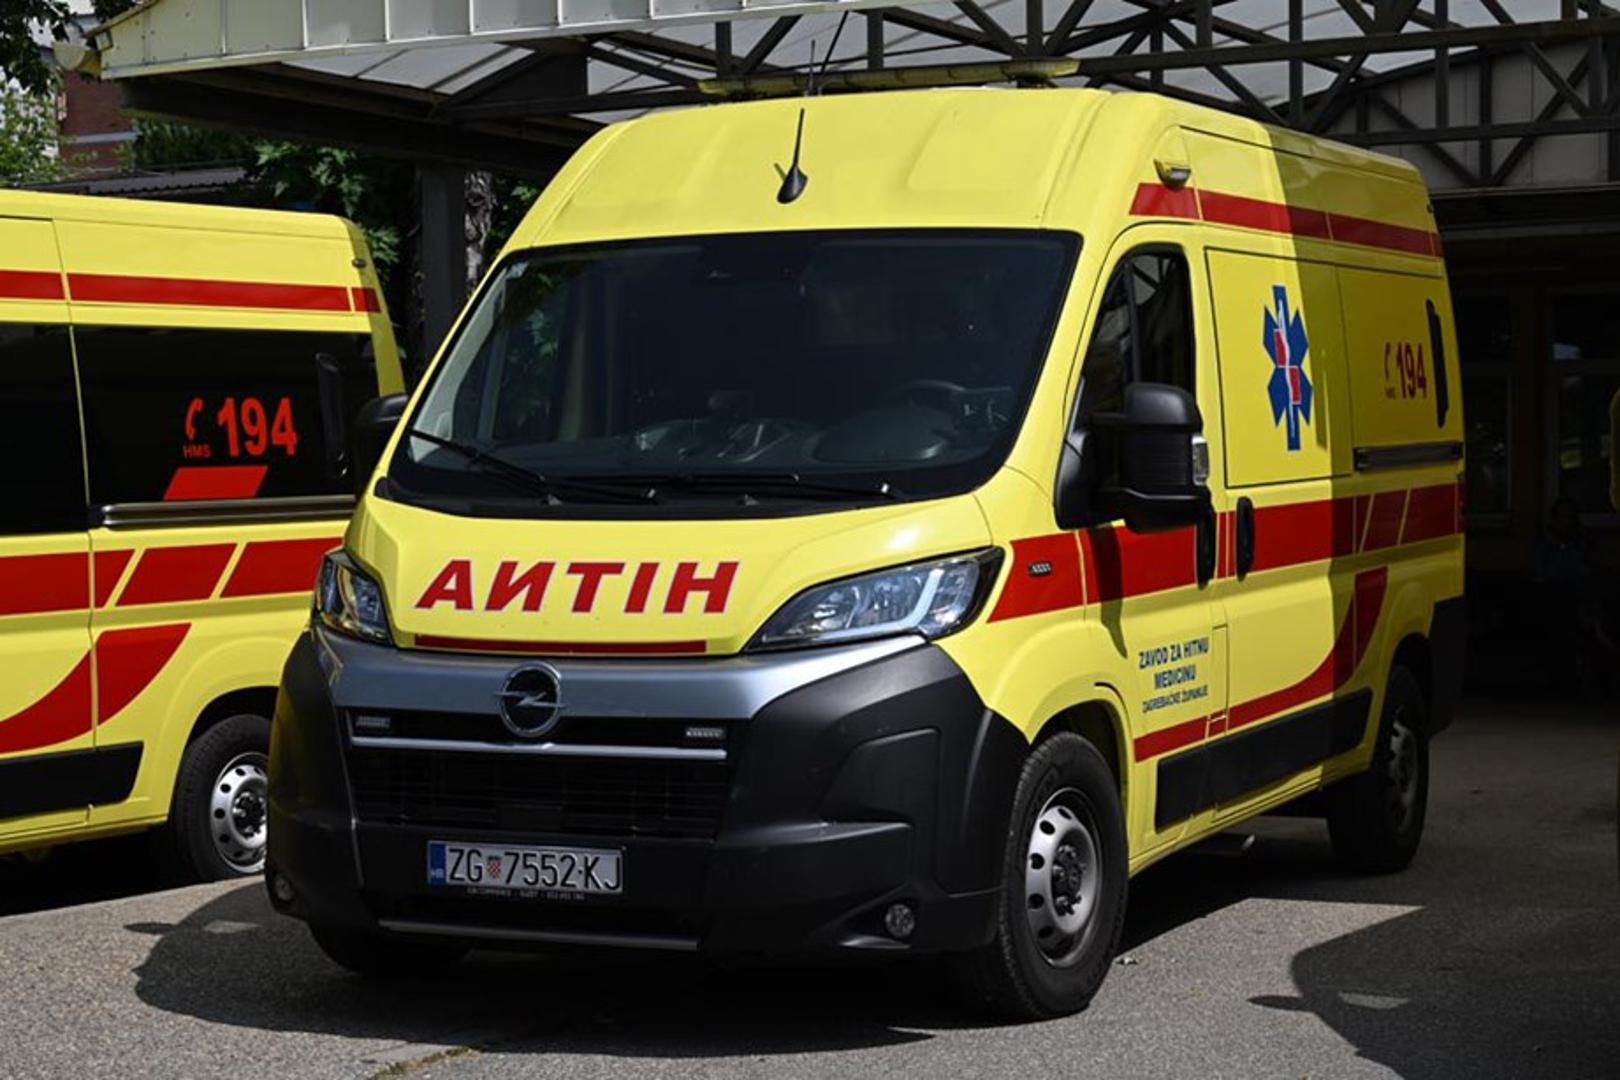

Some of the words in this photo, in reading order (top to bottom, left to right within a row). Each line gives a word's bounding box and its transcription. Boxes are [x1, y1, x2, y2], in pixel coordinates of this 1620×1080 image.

[1396, 342, 1427, 399] 194
[218, 398, 297, 456] 194
[183, 444, 211, 458] HMS
[1139, 646, 1168, 669] ZAVOD
[1170, 644, 1181, 661] ZA
[1184, 637, 1208, 658] HITNU
[1155, 665, 1196, 689] MEDICINU
[449, 848, 483, 883] ZG
